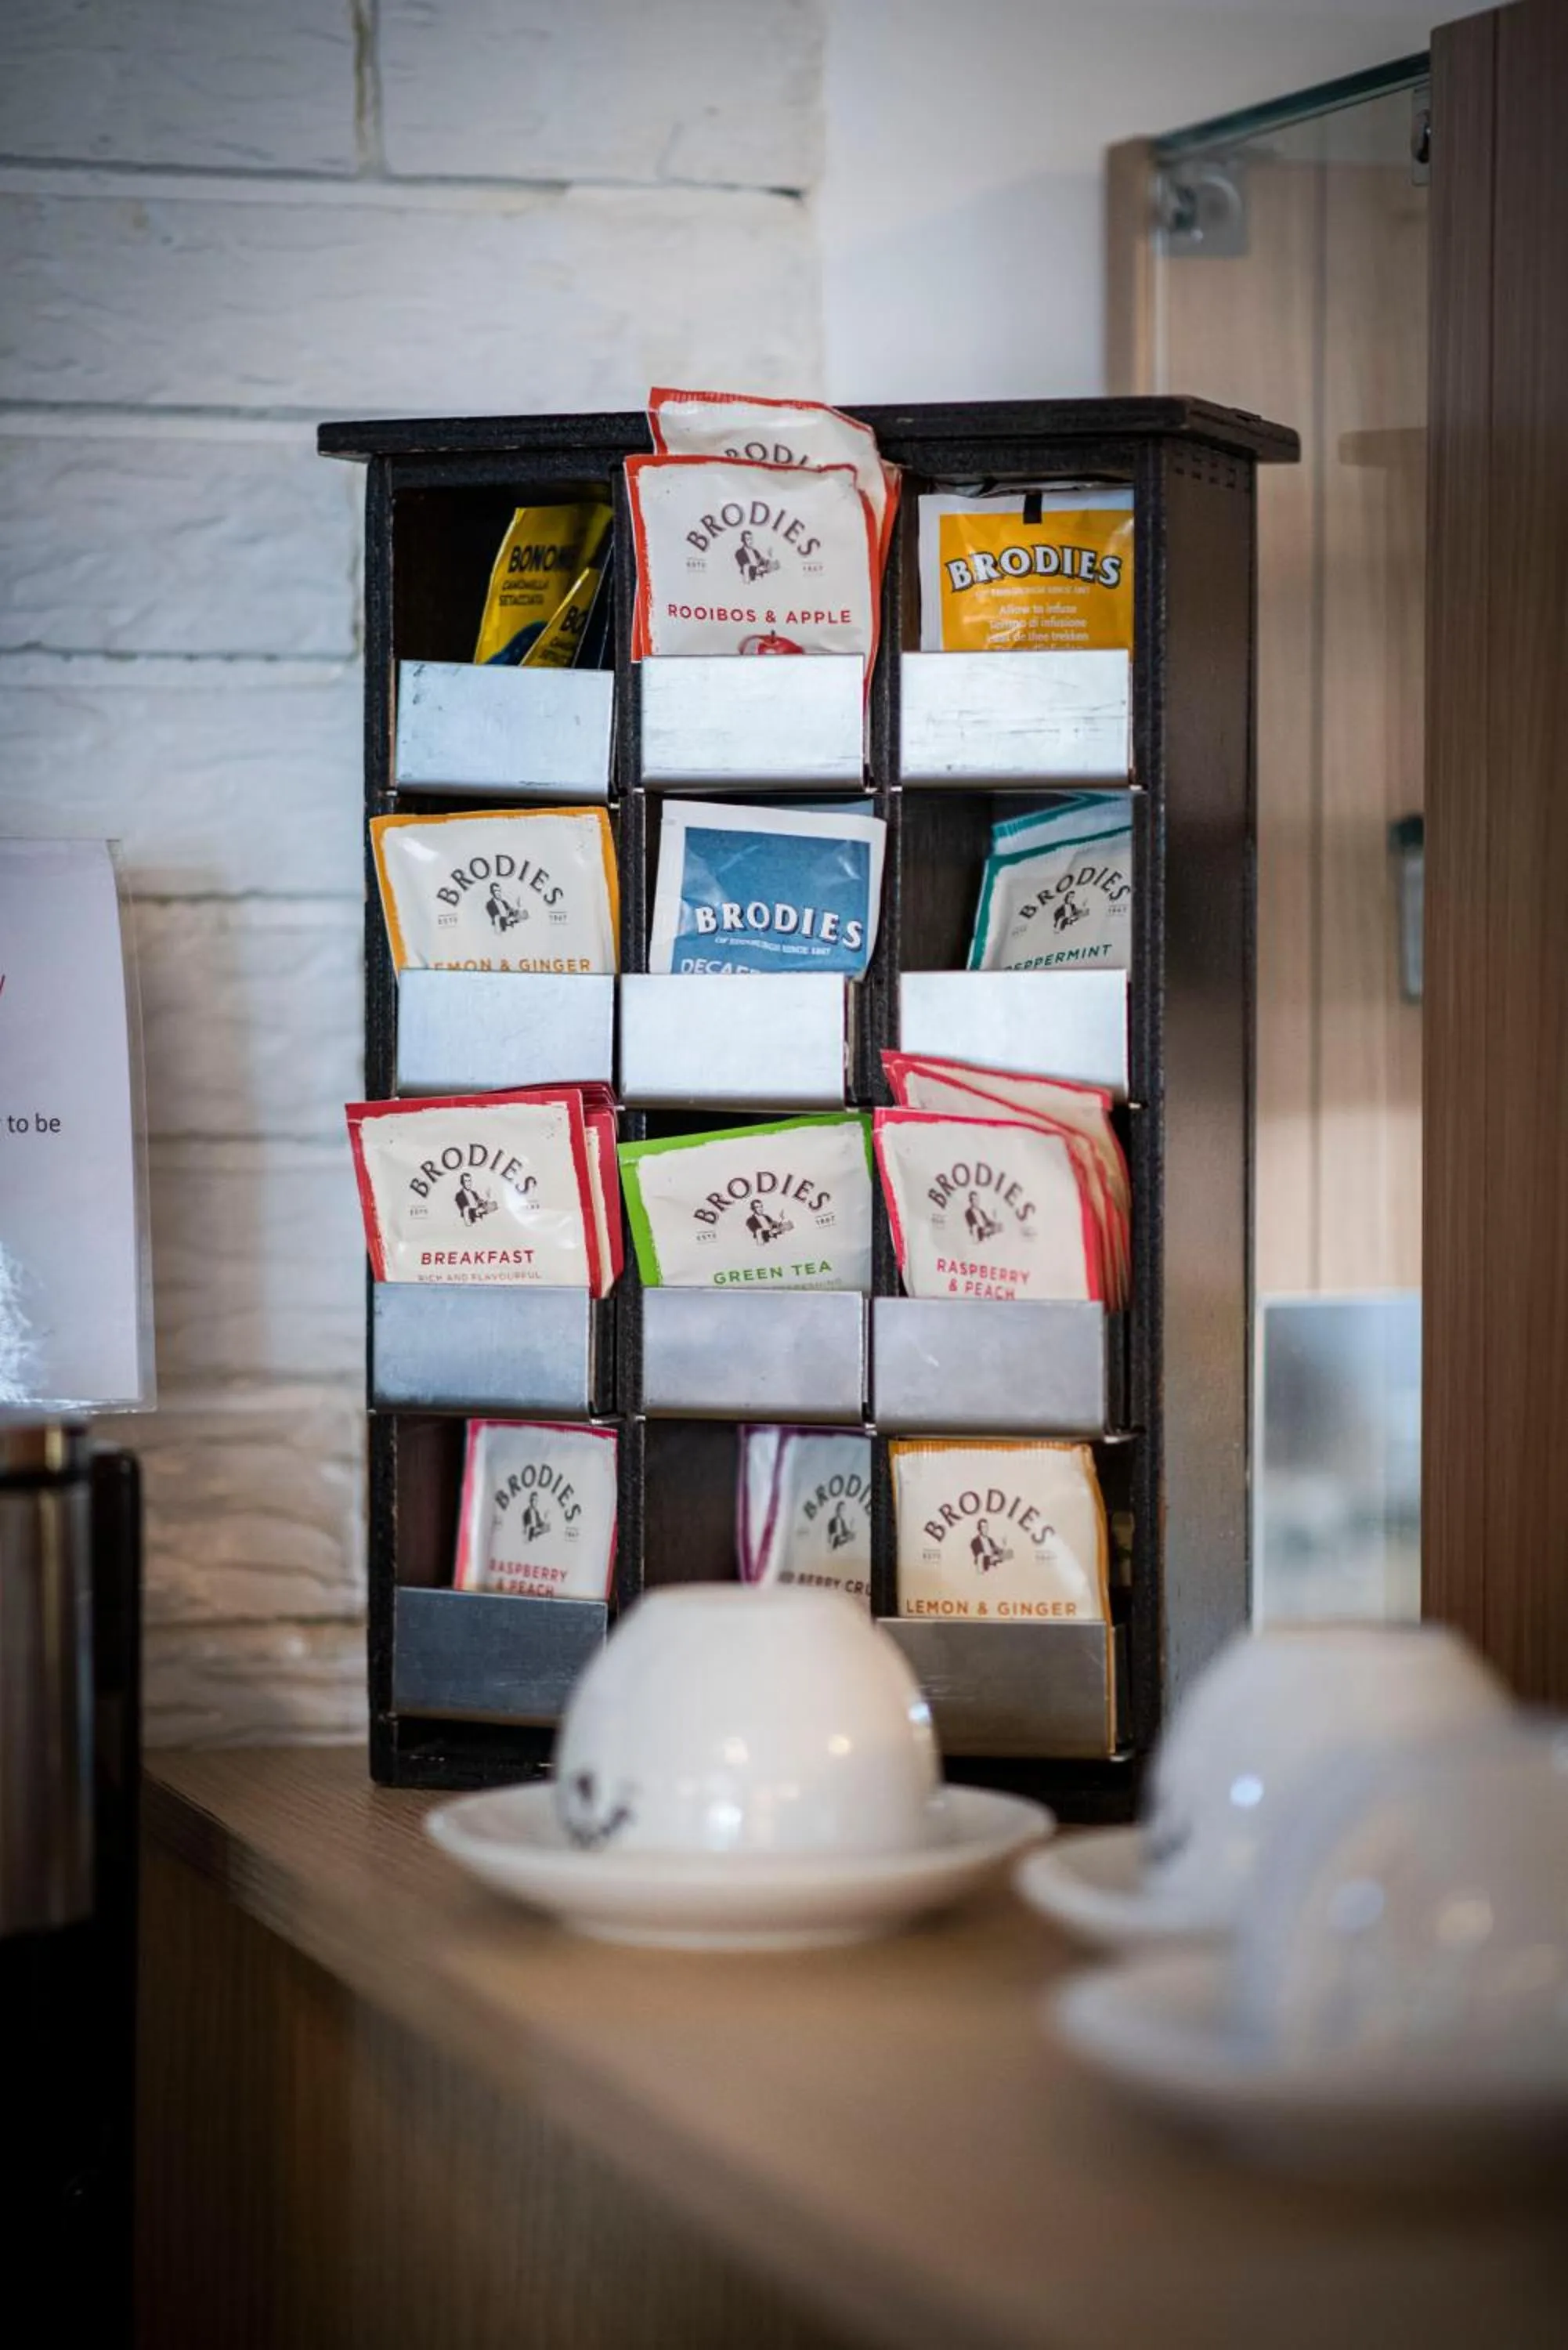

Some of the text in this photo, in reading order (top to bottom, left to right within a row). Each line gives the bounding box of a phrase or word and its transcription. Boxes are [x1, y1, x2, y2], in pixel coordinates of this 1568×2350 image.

[686, 501, 821, 556] BRODIES
[945, 544, 1122, 593] BRODIES
[668, 604, 851, 624] ROOIBOS & APPLE
[436, 855, 564, 907] BRODIES
[1020, 867, 1131, 919] BRODIES
[695, 902, 864, 951] BRODIES
[433, 958, 591, 973] EMON & GINGER
[8, 1112, 61, 1133] to be
[410, 1144, 537, 1198] BRODIES
[693, 1171, 831, 1224] BRODIES
[928, 1162, 1035, 1221] BRODIES
[421, 1249, 535, 1265] BREAKFAST
[714, 1260, 833, 1285] GREEN TEA
[937, 1258, 1030, 1285] RASPBERRY
[948, 1278, 1016, 1300] & PEACH
[494, 1463, 582, 1523] BRODIES
[923, 1488, 1055, 1546] BRODIES
[489, 1559, 569, 1582] RASPBERRY
[509, 1580, 555, 1596] PEACH
[906, 1599, 1077, 1616] LEMON & GINGER
